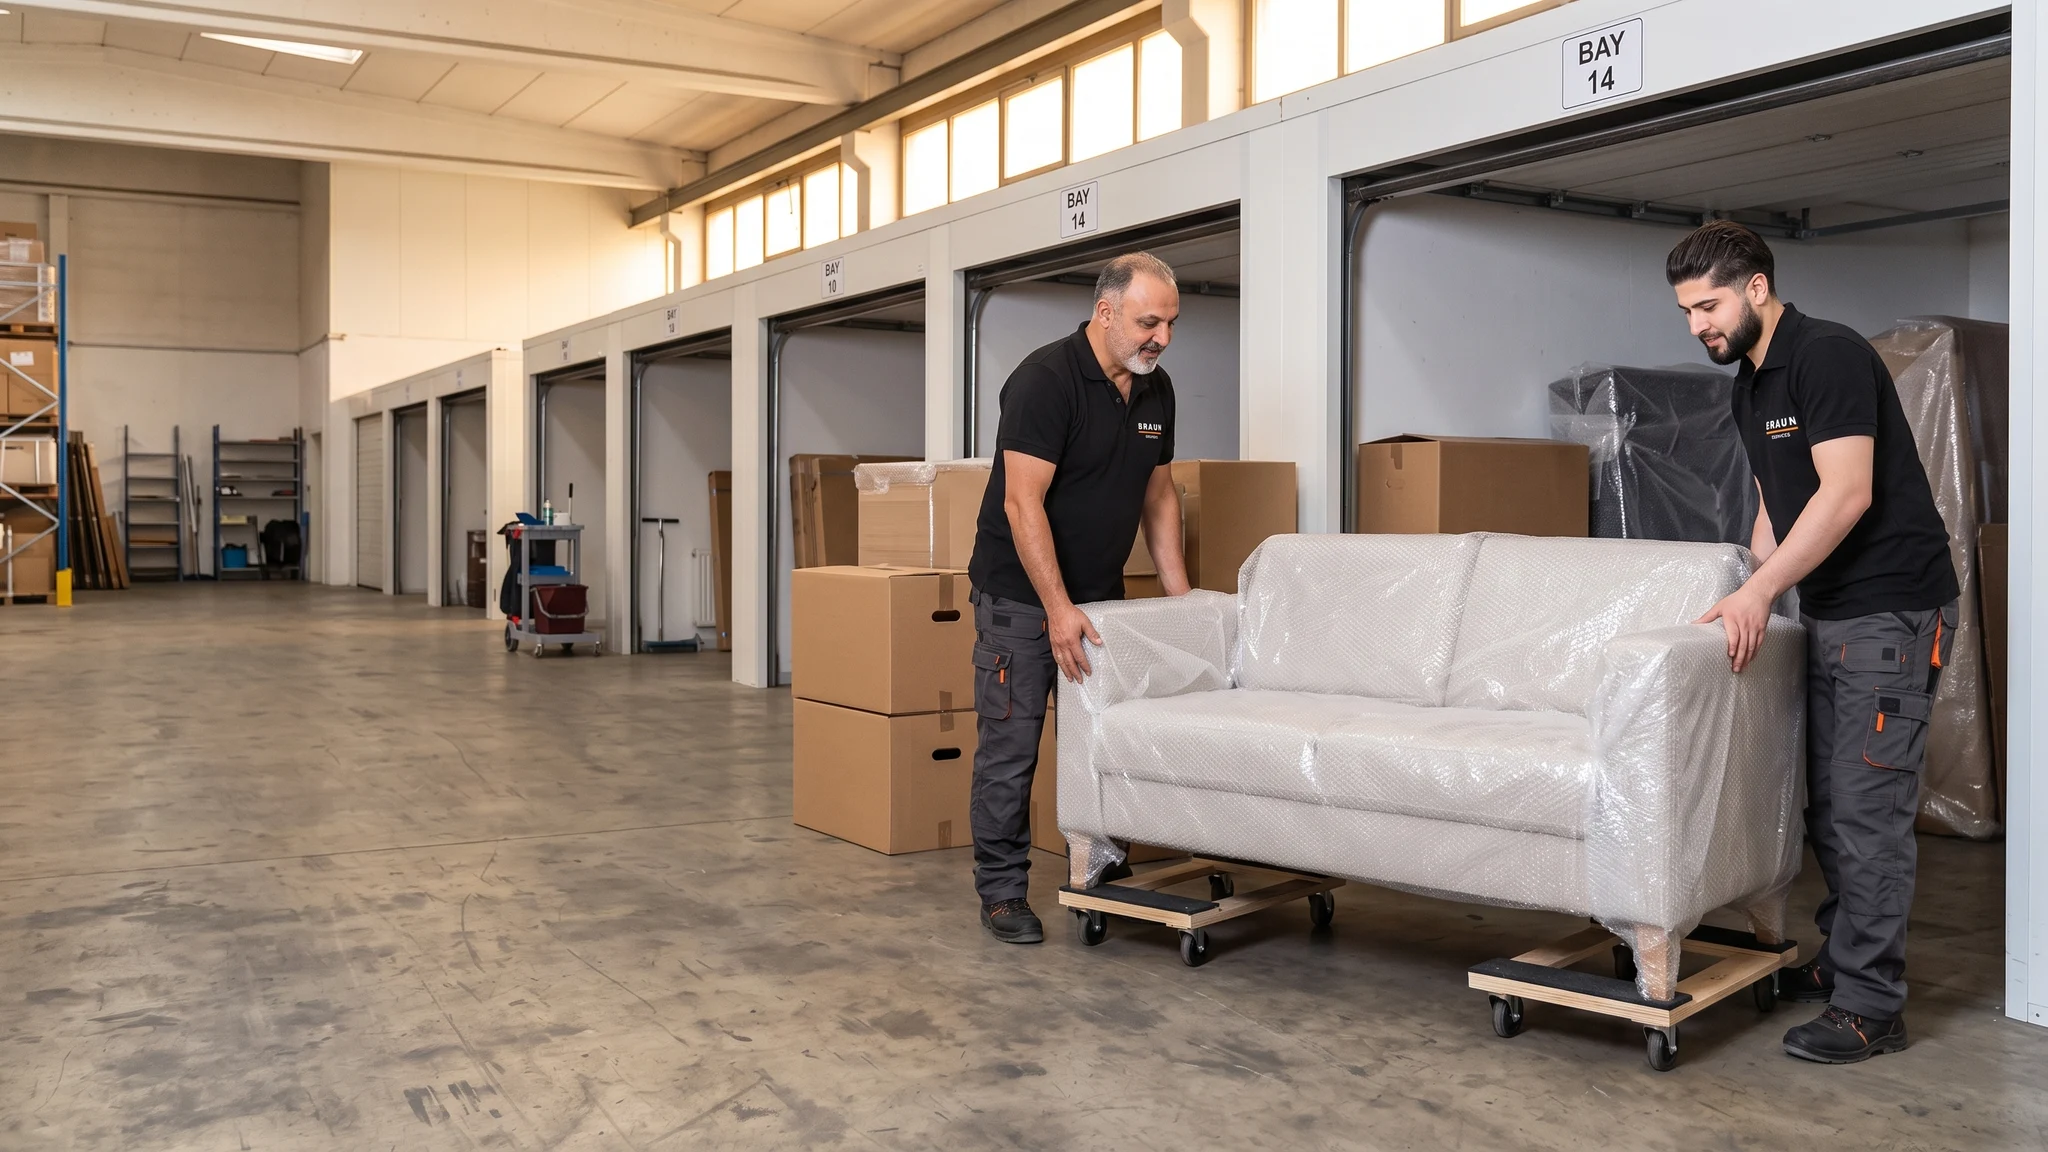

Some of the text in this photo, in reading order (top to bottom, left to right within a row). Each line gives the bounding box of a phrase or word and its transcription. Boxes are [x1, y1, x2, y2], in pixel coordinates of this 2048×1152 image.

[1579, 30, 1625, 65] BAY
[1588, 65, 1614, 94] 14
[1068, 187, 1090, 209] BAY
[1072, 211, 1085, 230] 14
[826, 260, 840, 276] BAY
[829, 279, 836, 293] 10
